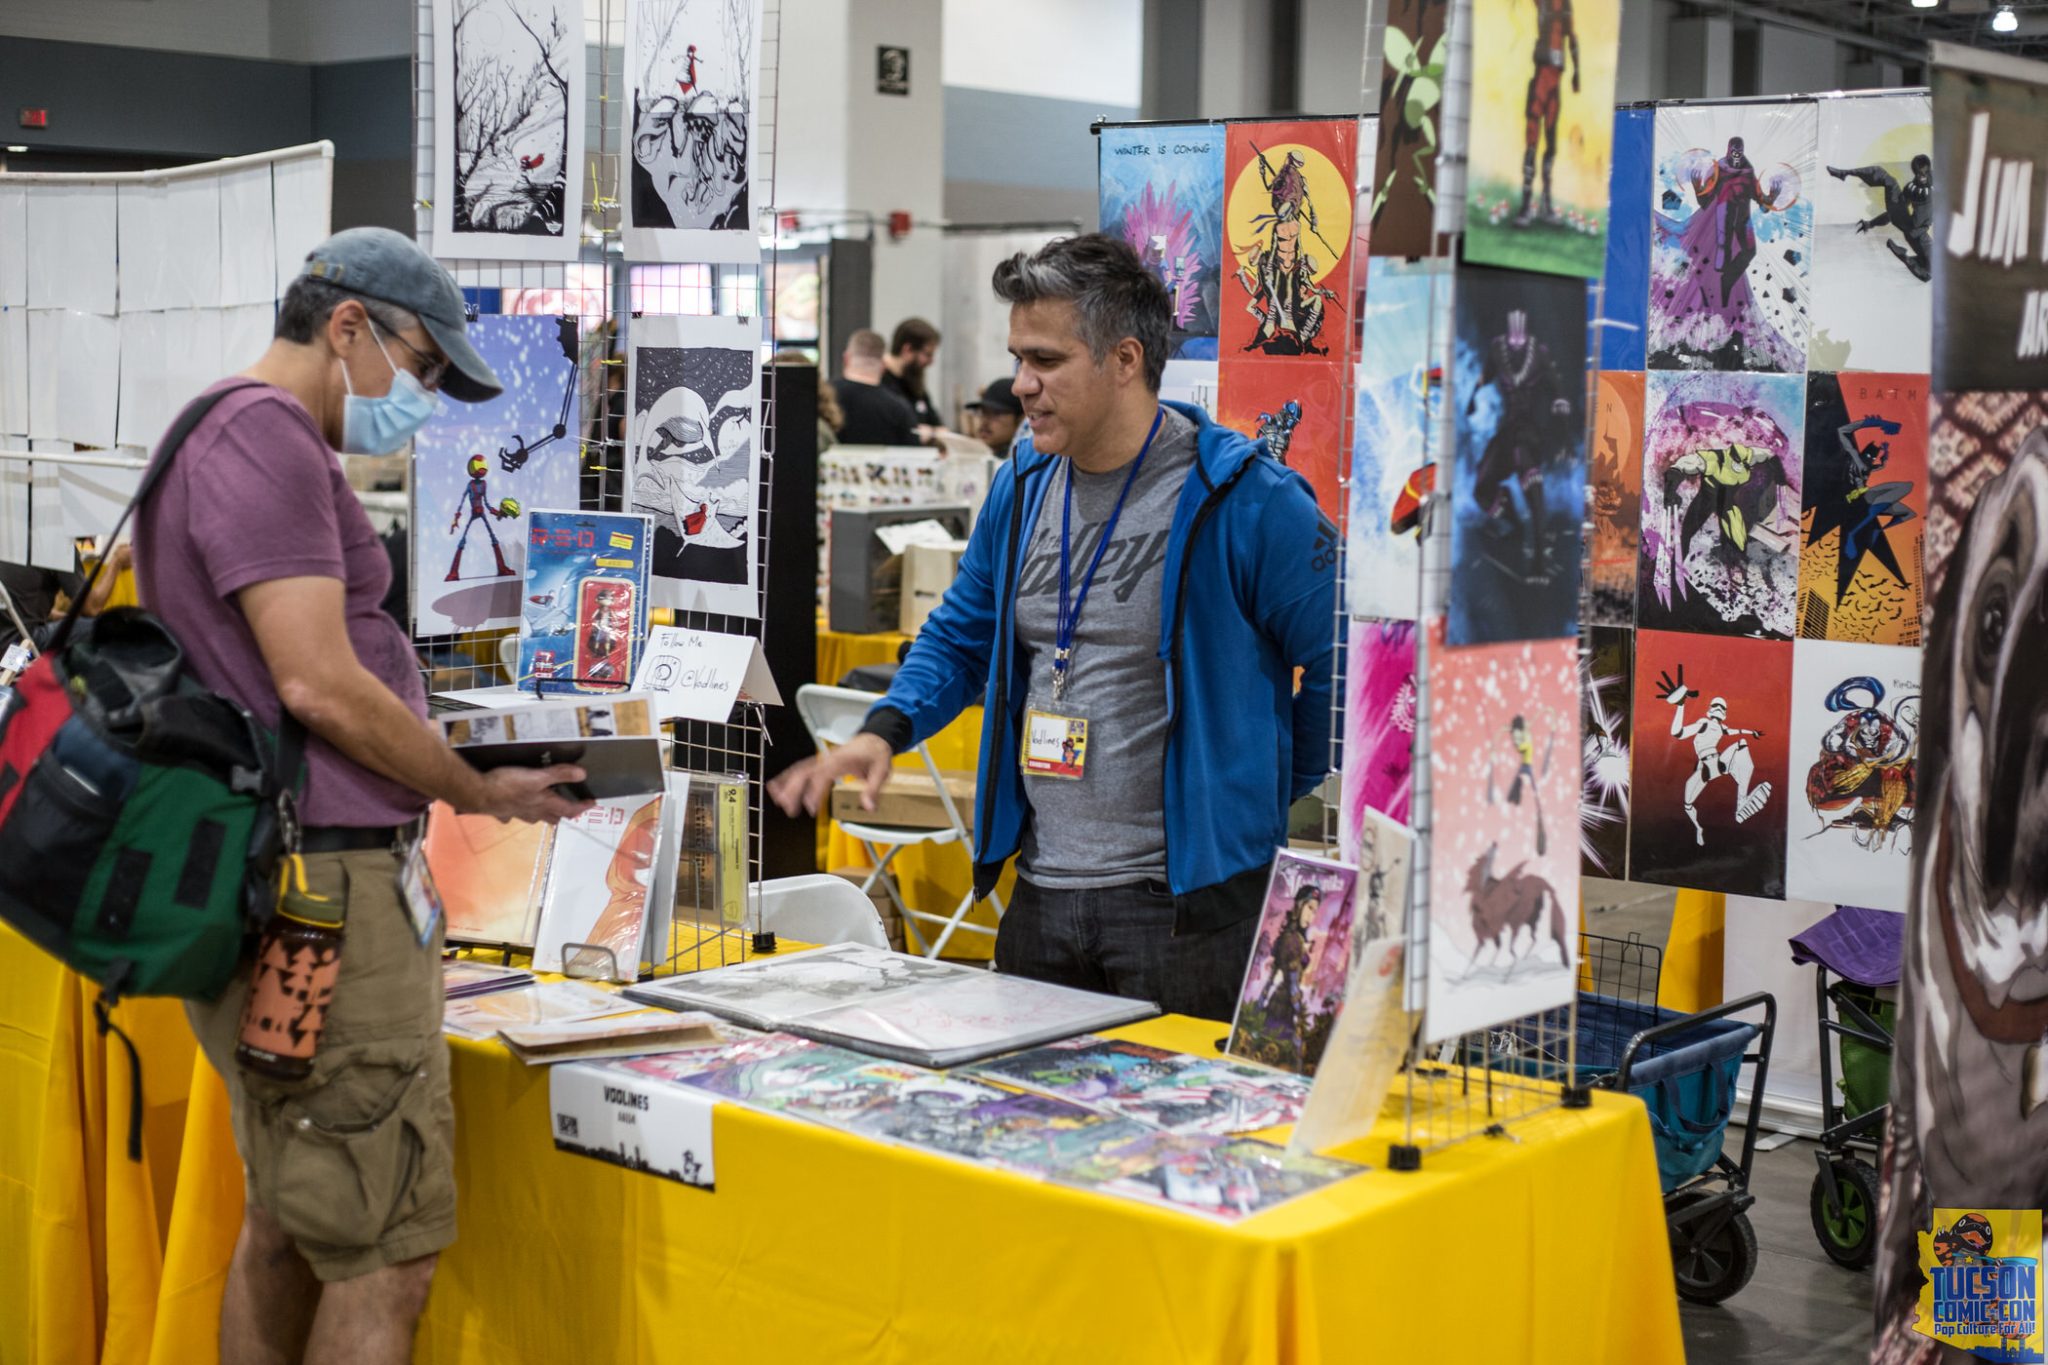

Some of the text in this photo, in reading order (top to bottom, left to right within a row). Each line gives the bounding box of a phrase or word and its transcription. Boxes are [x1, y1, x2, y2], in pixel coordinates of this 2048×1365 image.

[1948, 112, 2033, 268] JIM
[660, 632, 704, 648] Follow Me
